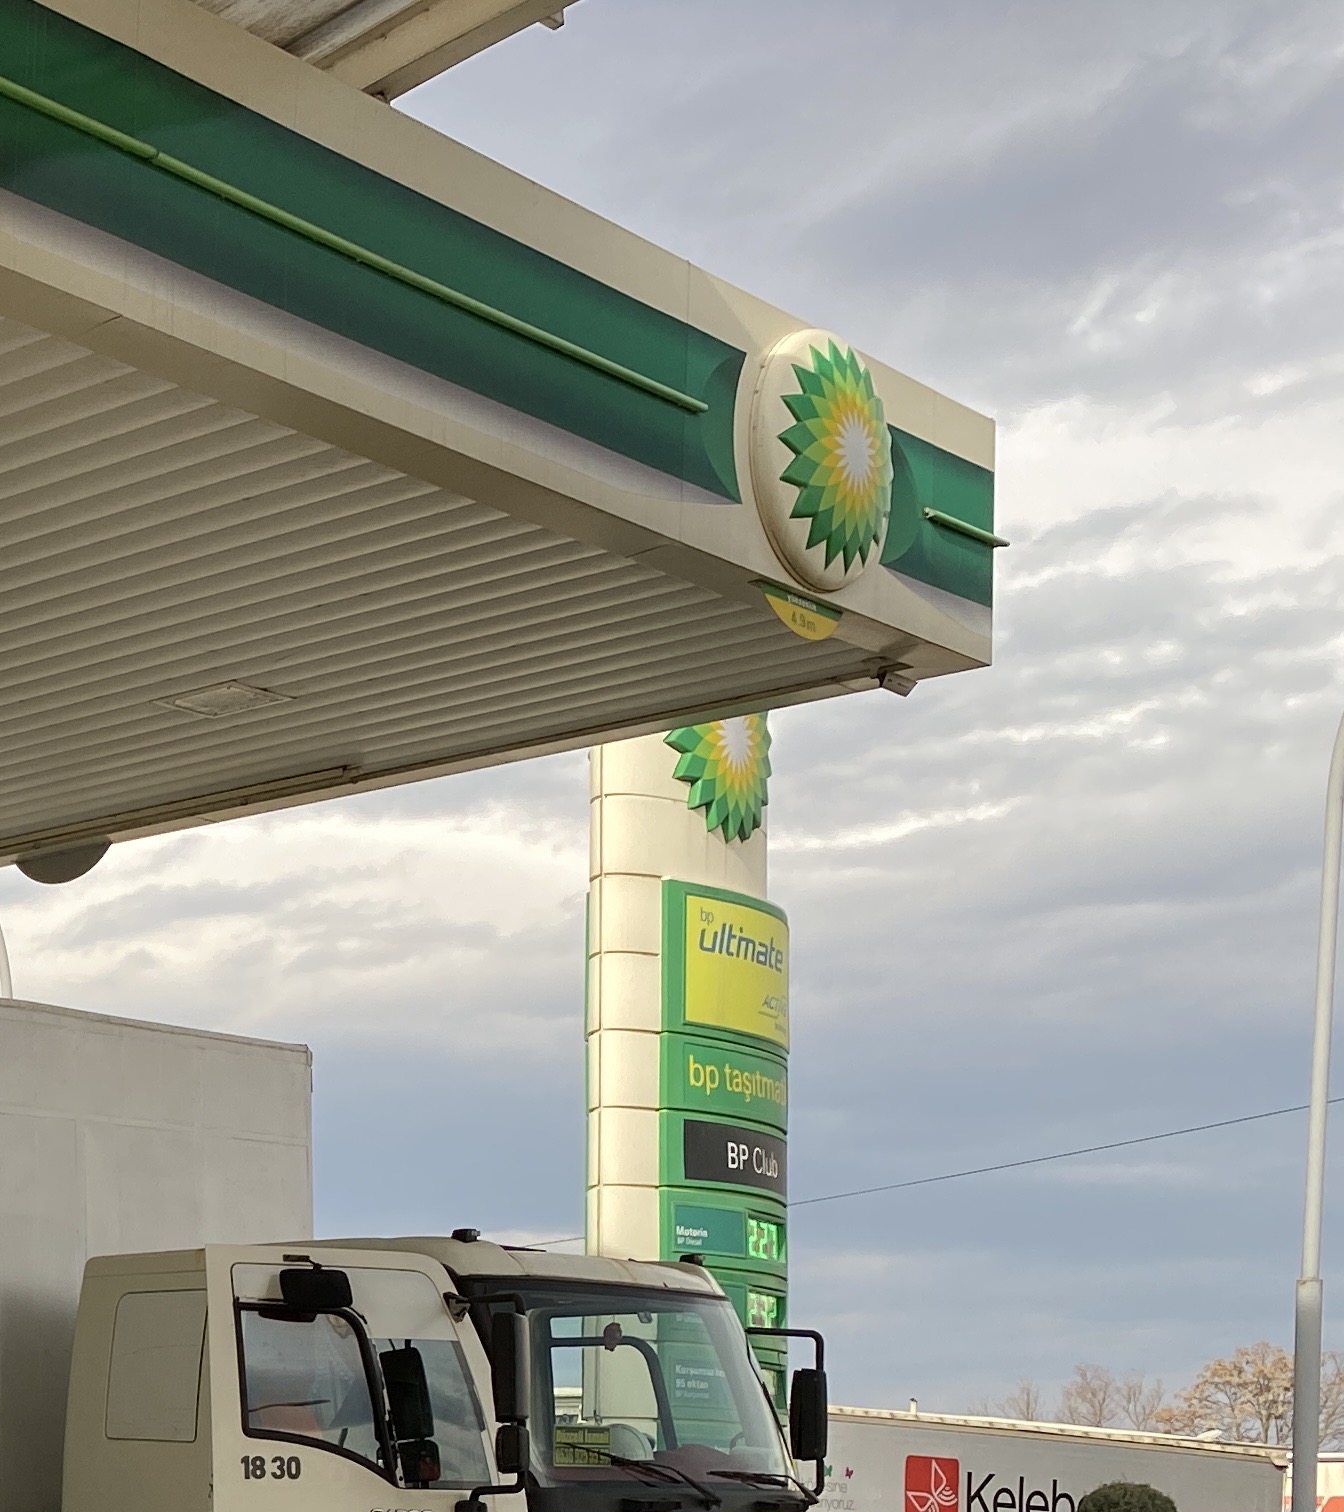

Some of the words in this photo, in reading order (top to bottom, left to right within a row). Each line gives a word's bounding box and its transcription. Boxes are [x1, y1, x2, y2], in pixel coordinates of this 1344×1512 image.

[700, 906, 714, 925] bp
[699, 923, 783, 973] ultimate
[688, 1054, 719, 1095] bp
[727, 1141, 749, 1170] BP
[753, 1147, 778, 1178] Club
[675, 1225, 708, 1238] Motorin
